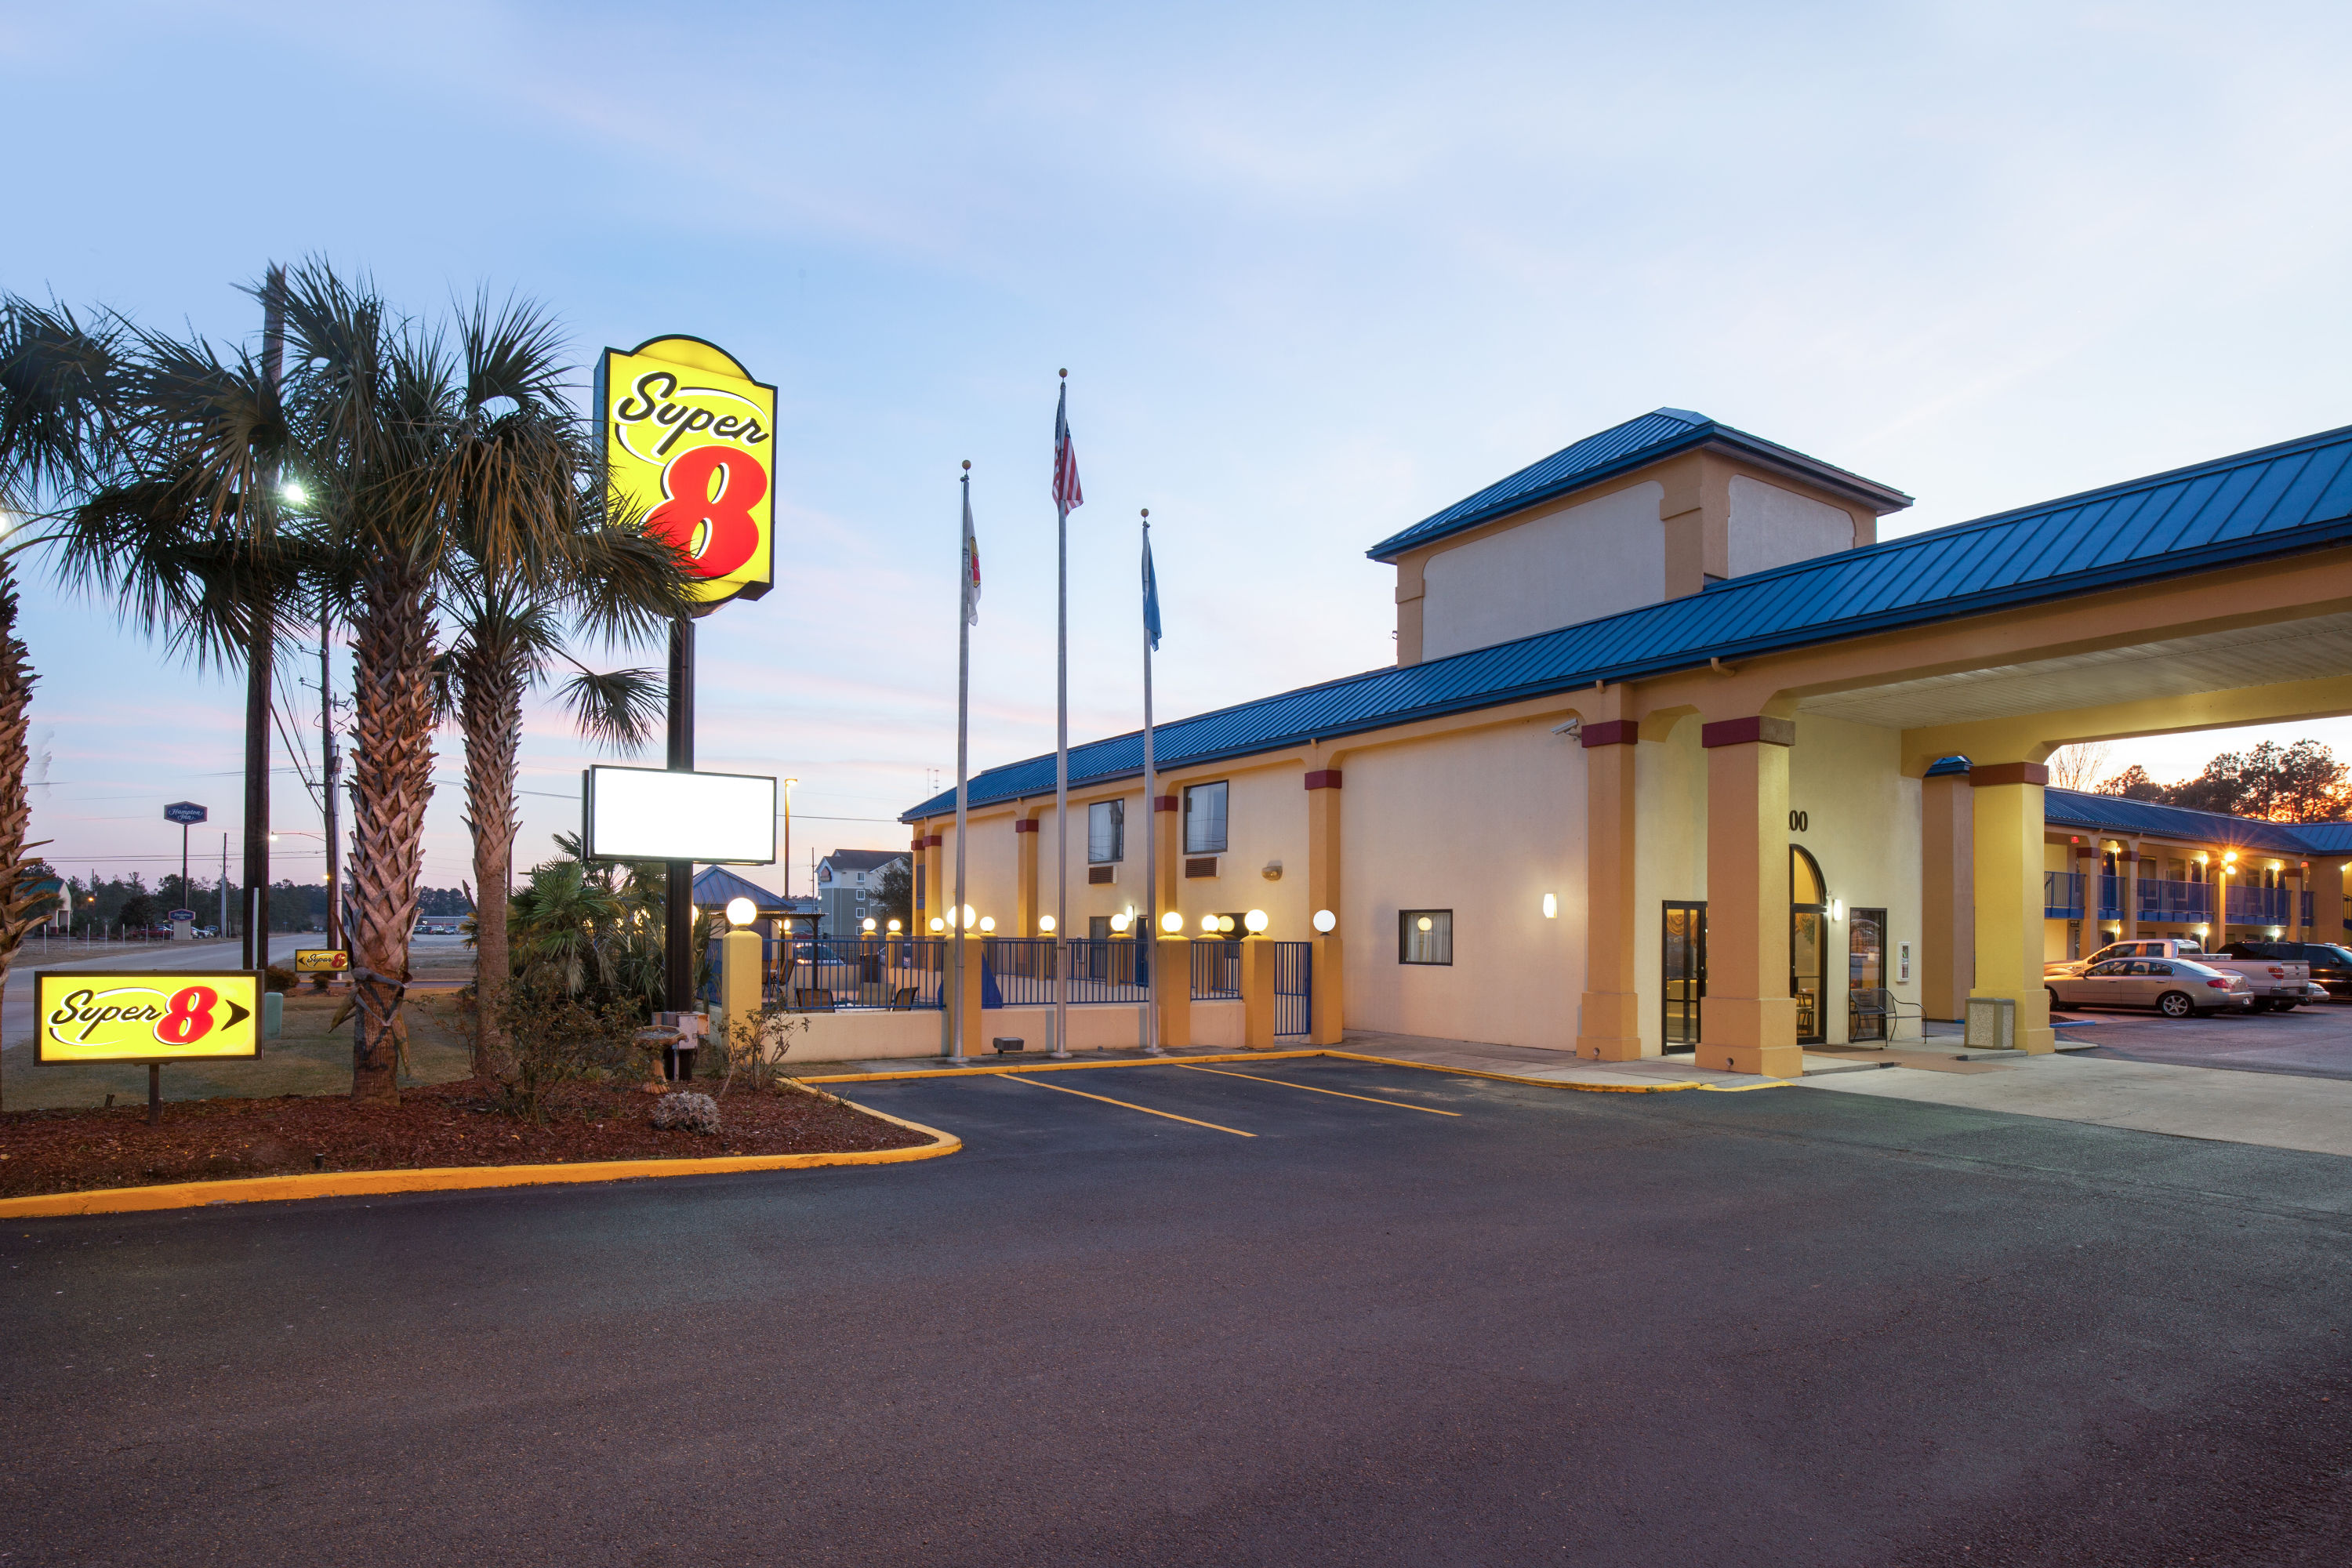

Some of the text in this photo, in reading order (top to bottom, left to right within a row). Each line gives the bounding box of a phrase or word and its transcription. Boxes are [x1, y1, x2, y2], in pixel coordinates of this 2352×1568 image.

[615, 372, 769, 456] Super
[638, 445, 768, 581] 8
[1788, 810, 1808, 832] 00
[307, 953, 346, 967] Super 8
[50, 985, 218, 1045] Super 8
